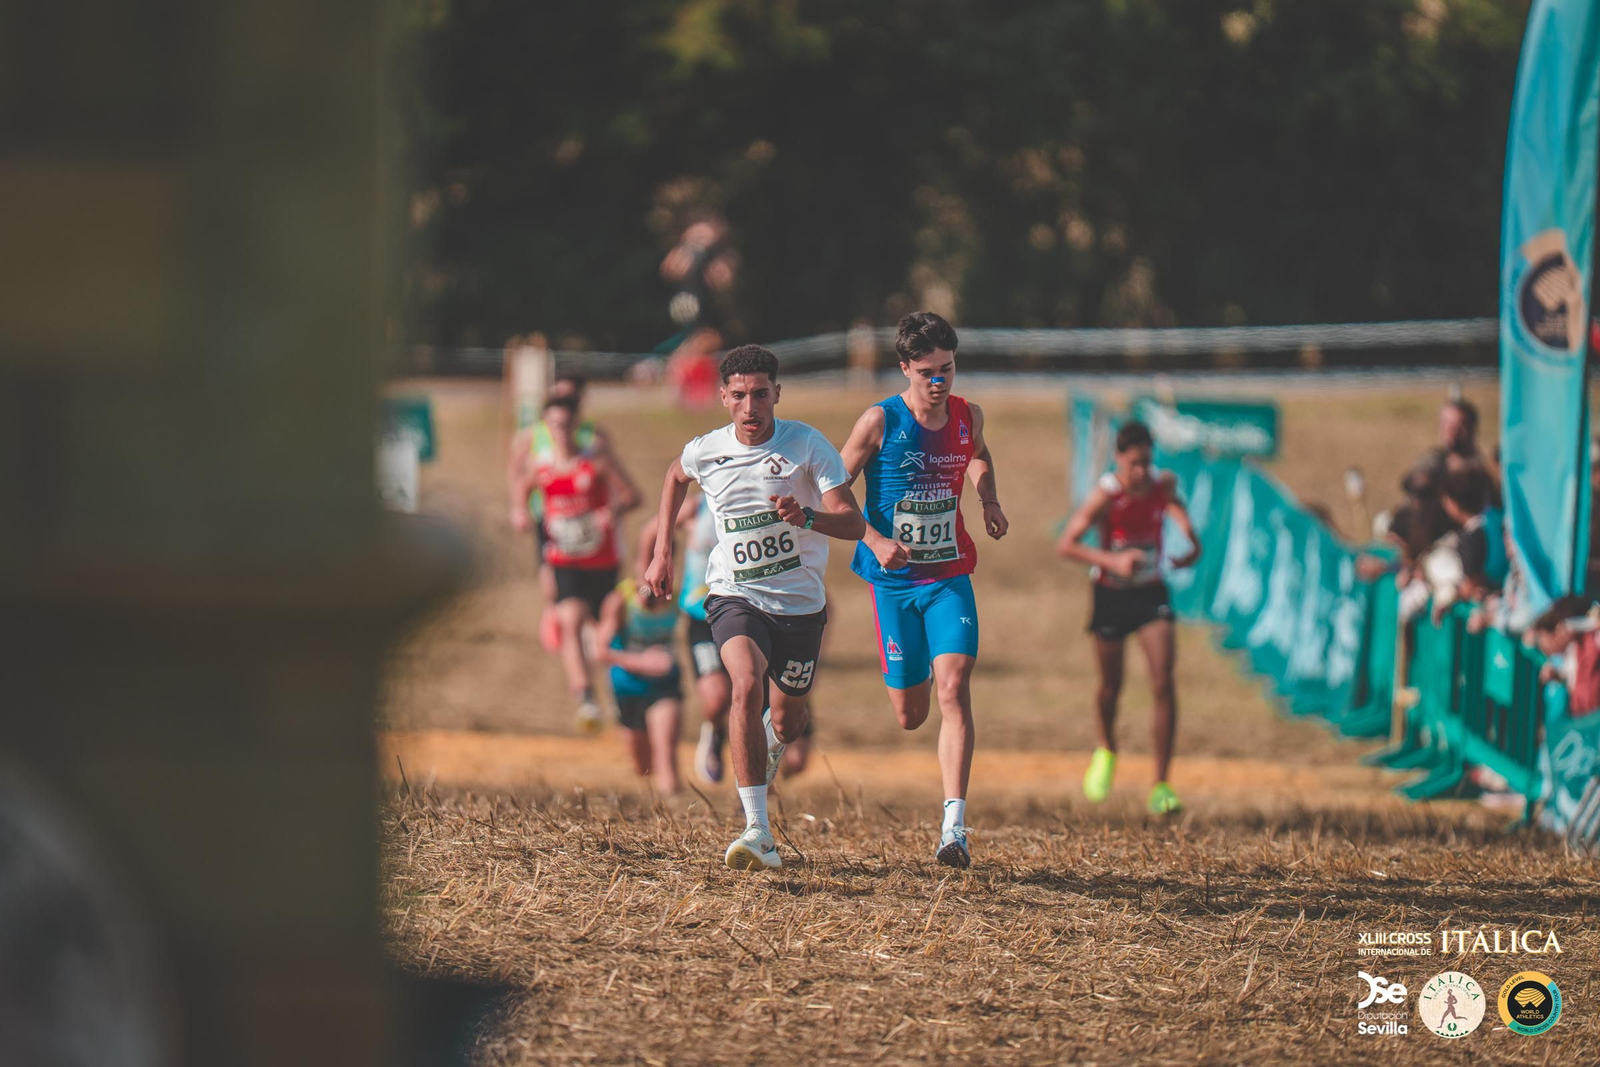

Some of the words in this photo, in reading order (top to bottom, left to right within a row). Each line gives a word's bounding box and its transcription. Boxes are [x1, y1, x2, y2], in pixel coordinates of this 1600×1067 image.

[929, 453, 966, 467] lapalma
[899, 521, 952, 545] 8191
[733, 530, 794, 565] 6086
[780, 658, 815, 689] 23
